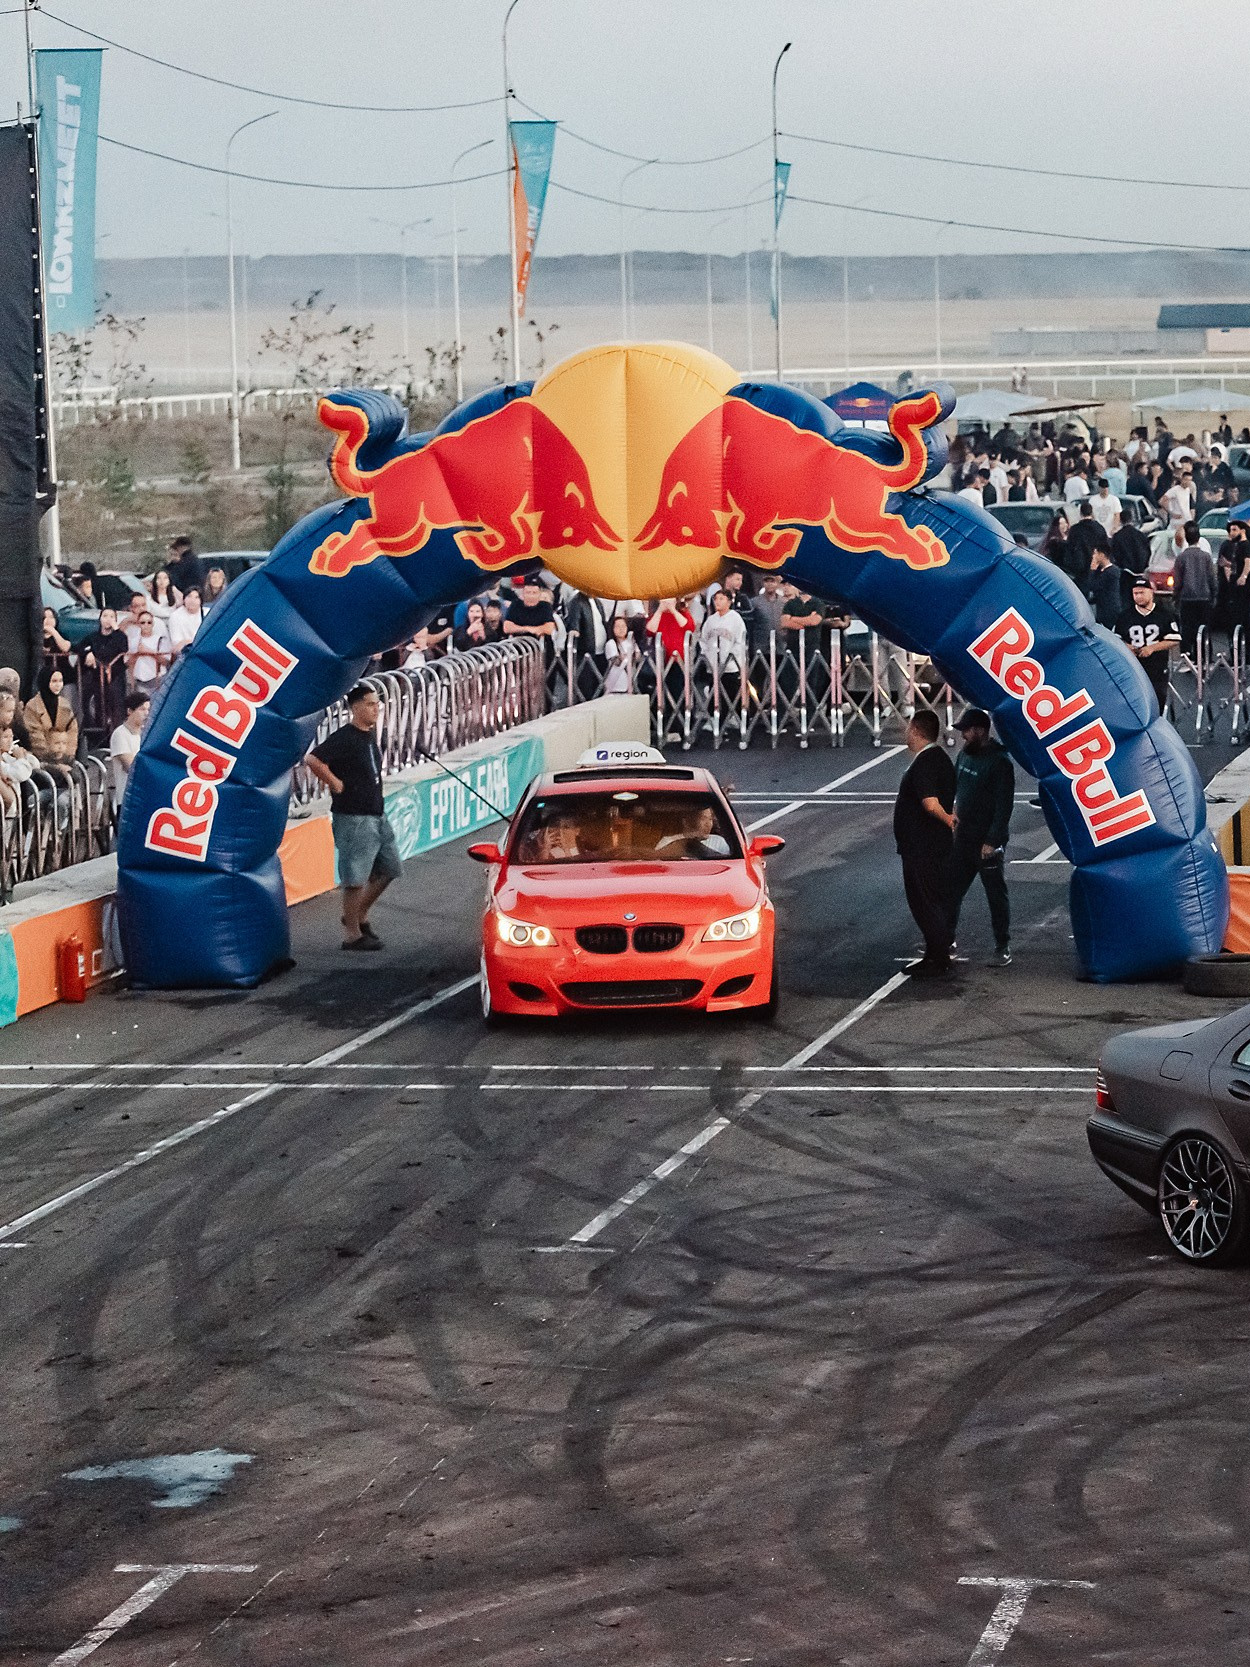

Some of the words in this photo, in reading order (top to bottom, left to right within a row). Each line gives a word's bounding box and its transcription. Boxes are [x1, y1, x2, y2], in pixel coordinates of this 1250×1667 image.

[186, 618, 299, 749] Bull
[965, 606, 1095, 740] Red
[1046, 717, 1157, 848] Bull
[145, 728, 237, 862] Red
[611, 750, 648, 760] region
